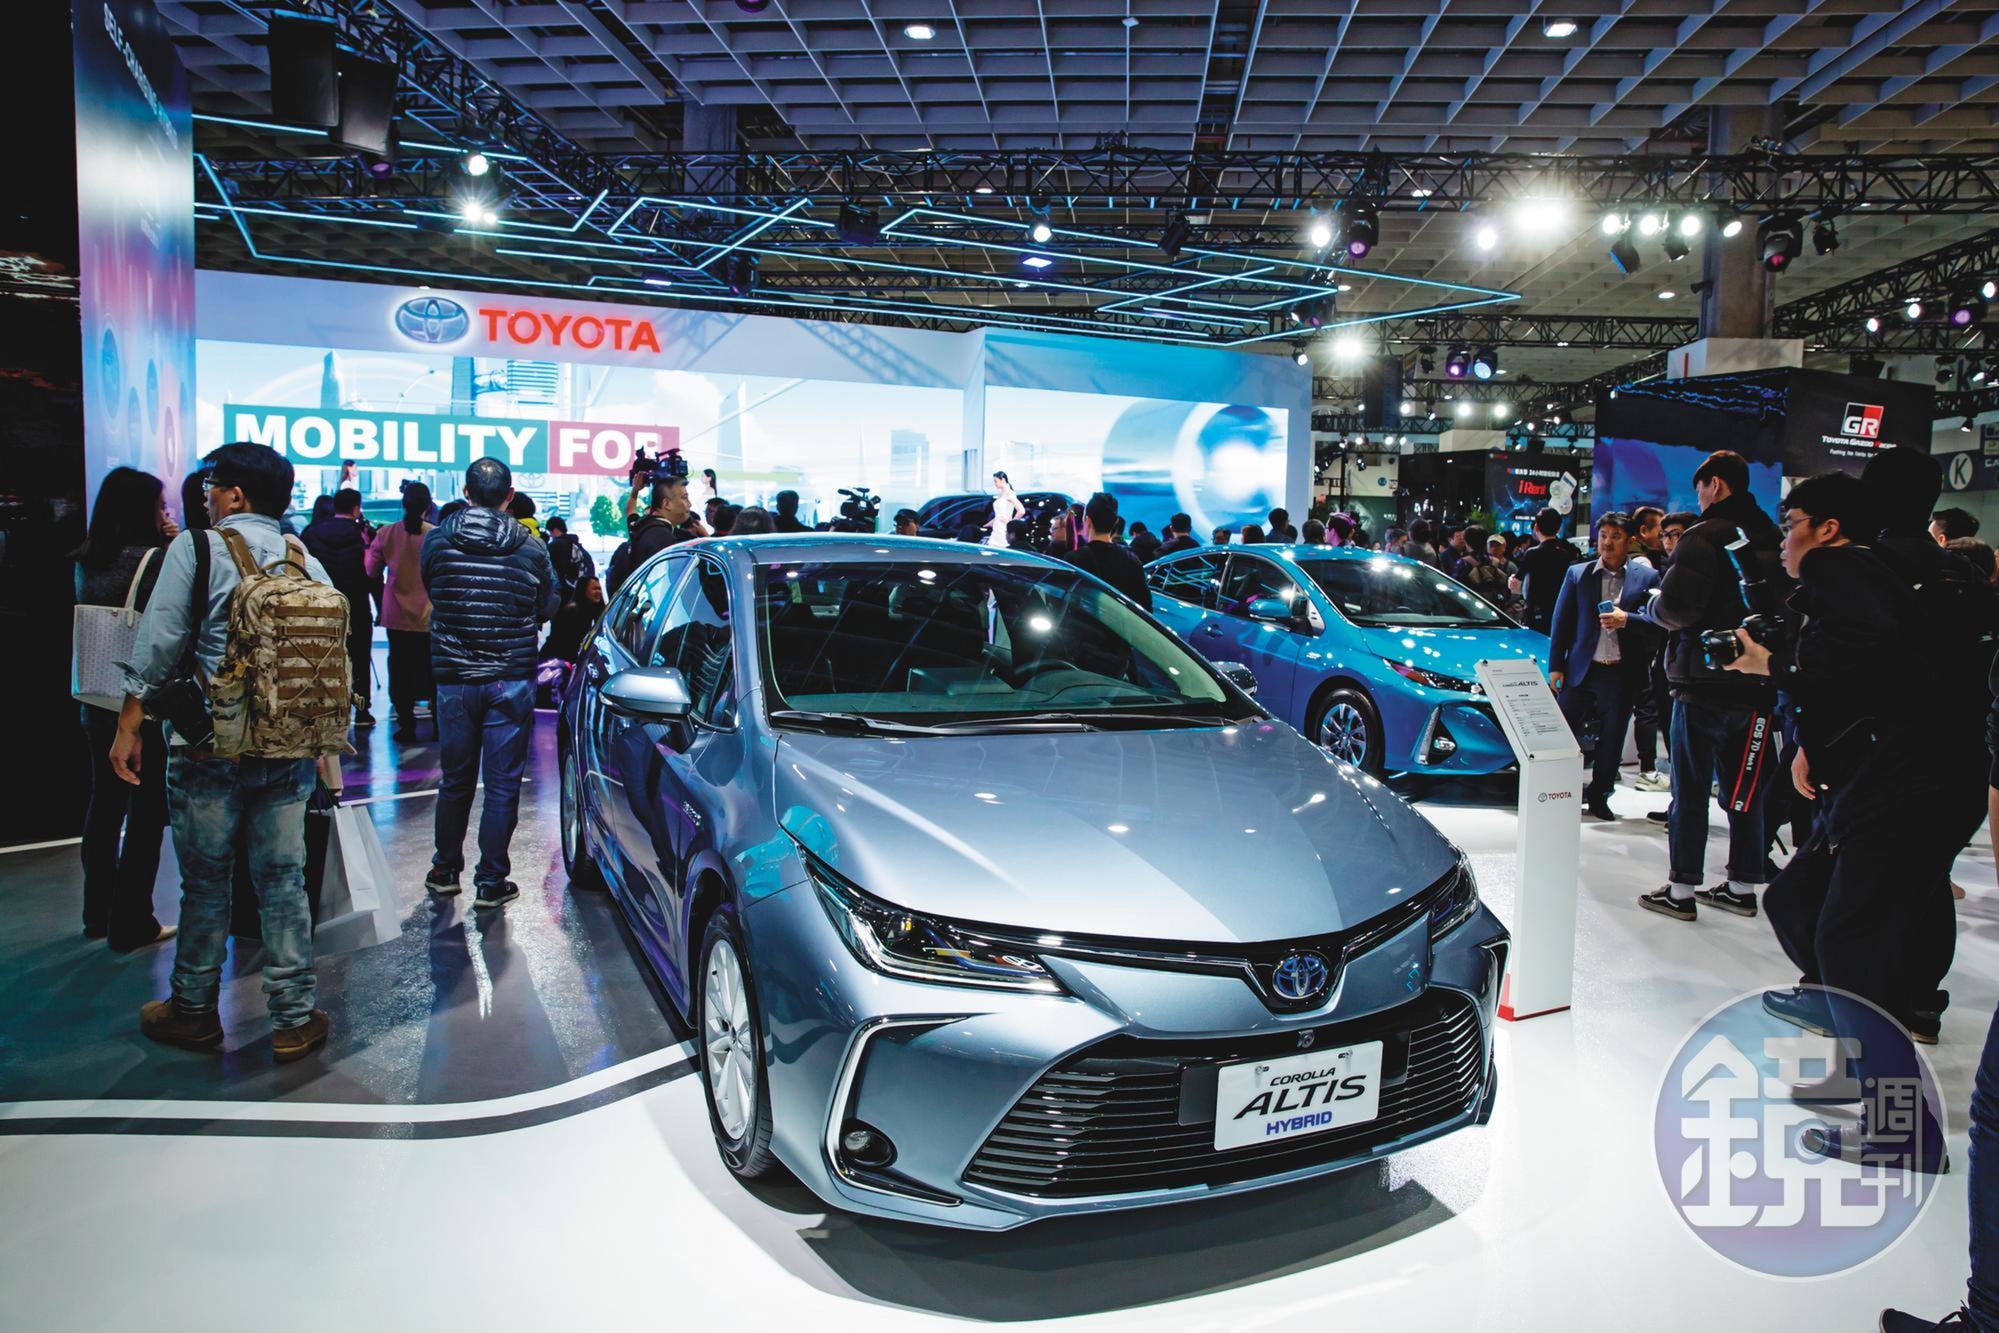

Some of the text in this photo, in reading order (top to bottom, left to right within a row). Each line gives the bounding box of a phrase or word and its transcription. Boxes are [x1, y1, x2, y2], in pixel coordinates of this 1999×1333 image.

[479, 309, 661, 353] TOYOTA
[1844, 416, 1878, 435] GR
[235, 413, 537, 467] MOBILITY
[1822, 435, 1849, 445] TOYOTA
[1954, 458, 1968, 485] K
[1753, 717, 1766, 738] EOS
[1548, 791, 1572, 800] TOYOTA
[1270, 1067, 1336, 1086] COROLLA
[1233, 1075, 1366, 1120] ALTIS
[1266, 1111, 1332, 1135] HYBRID
